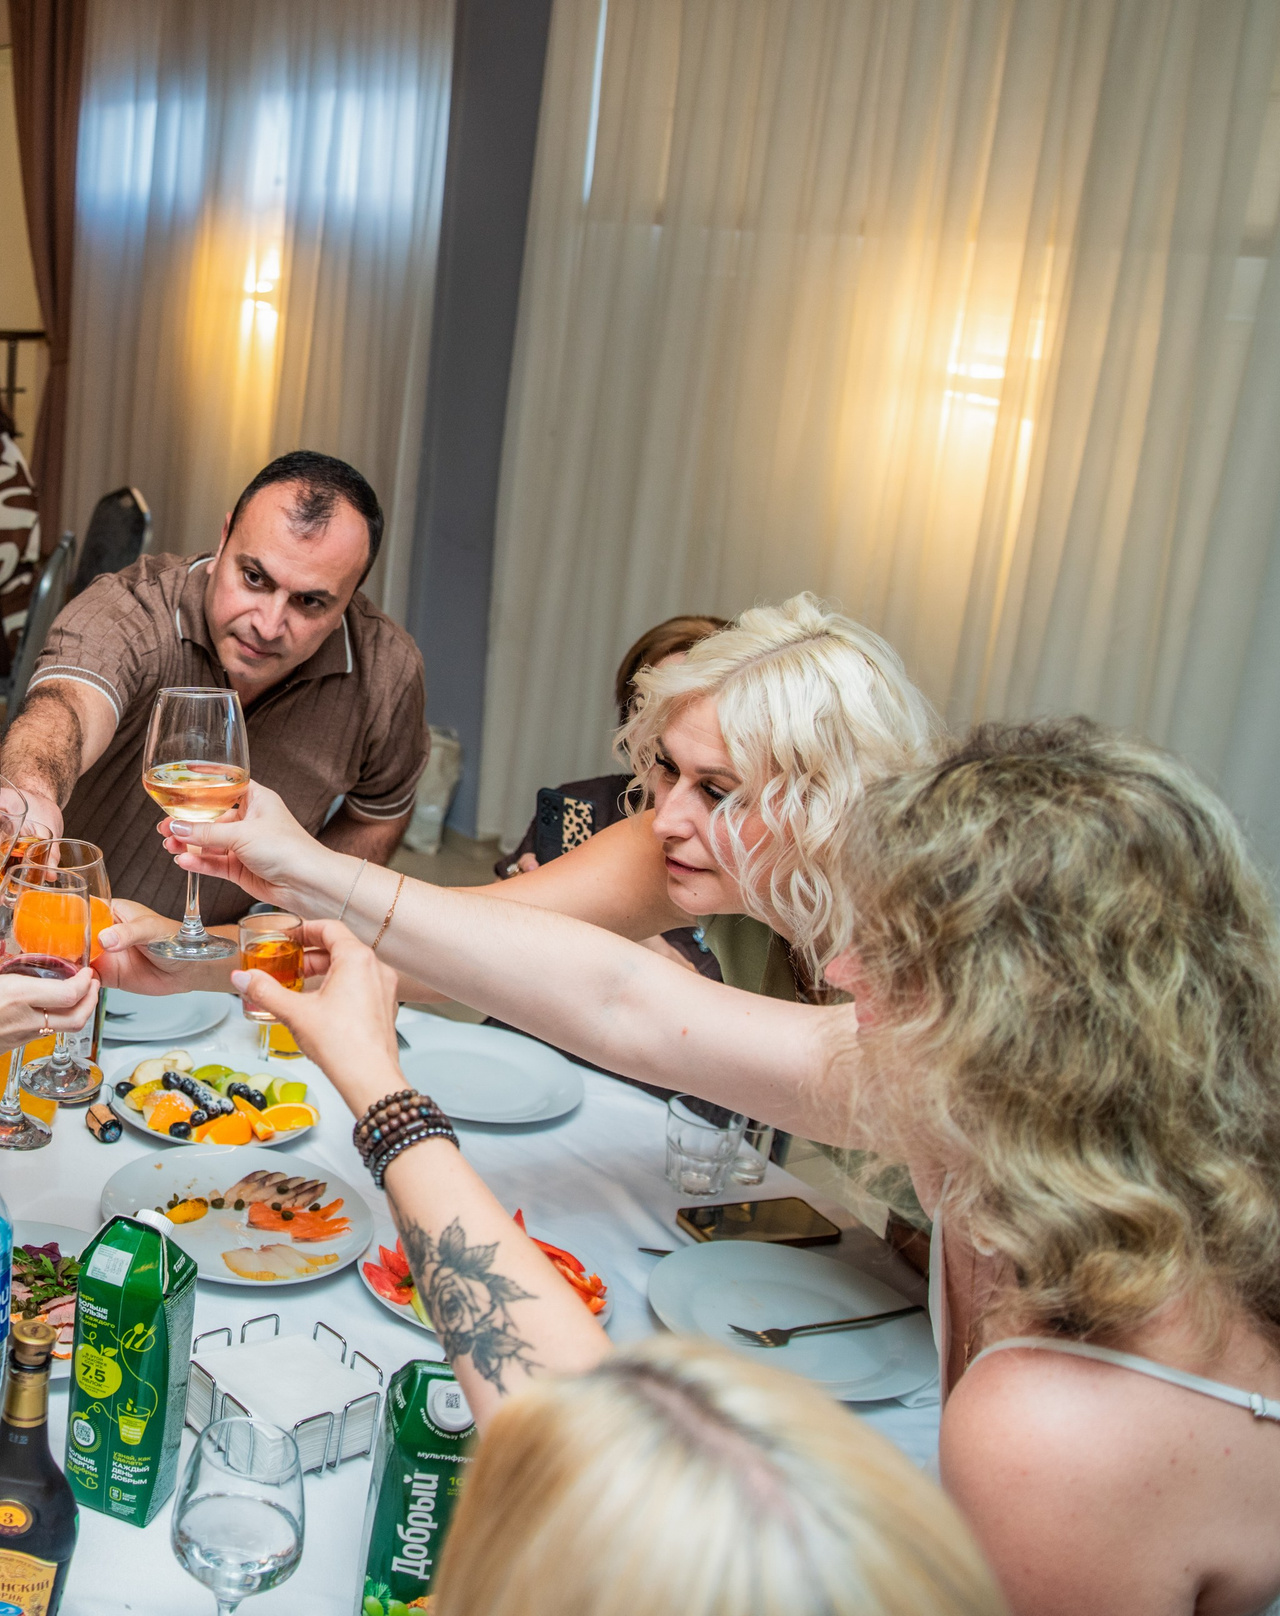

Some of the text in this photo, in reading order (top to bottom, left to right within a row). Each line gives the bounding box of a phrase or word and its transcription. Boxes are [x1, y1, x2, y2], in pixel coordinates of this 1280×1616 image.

[111, 1466, 134, 1478] ДЕНЬ
[112, 1460, 150, 1473] КАЖДЫЙ
[111, 1473, 148, 1485] ДОБРЫМ
[3, 1512, 13, 1524] 3
[391, 1473, 440, 1580] Добрый
